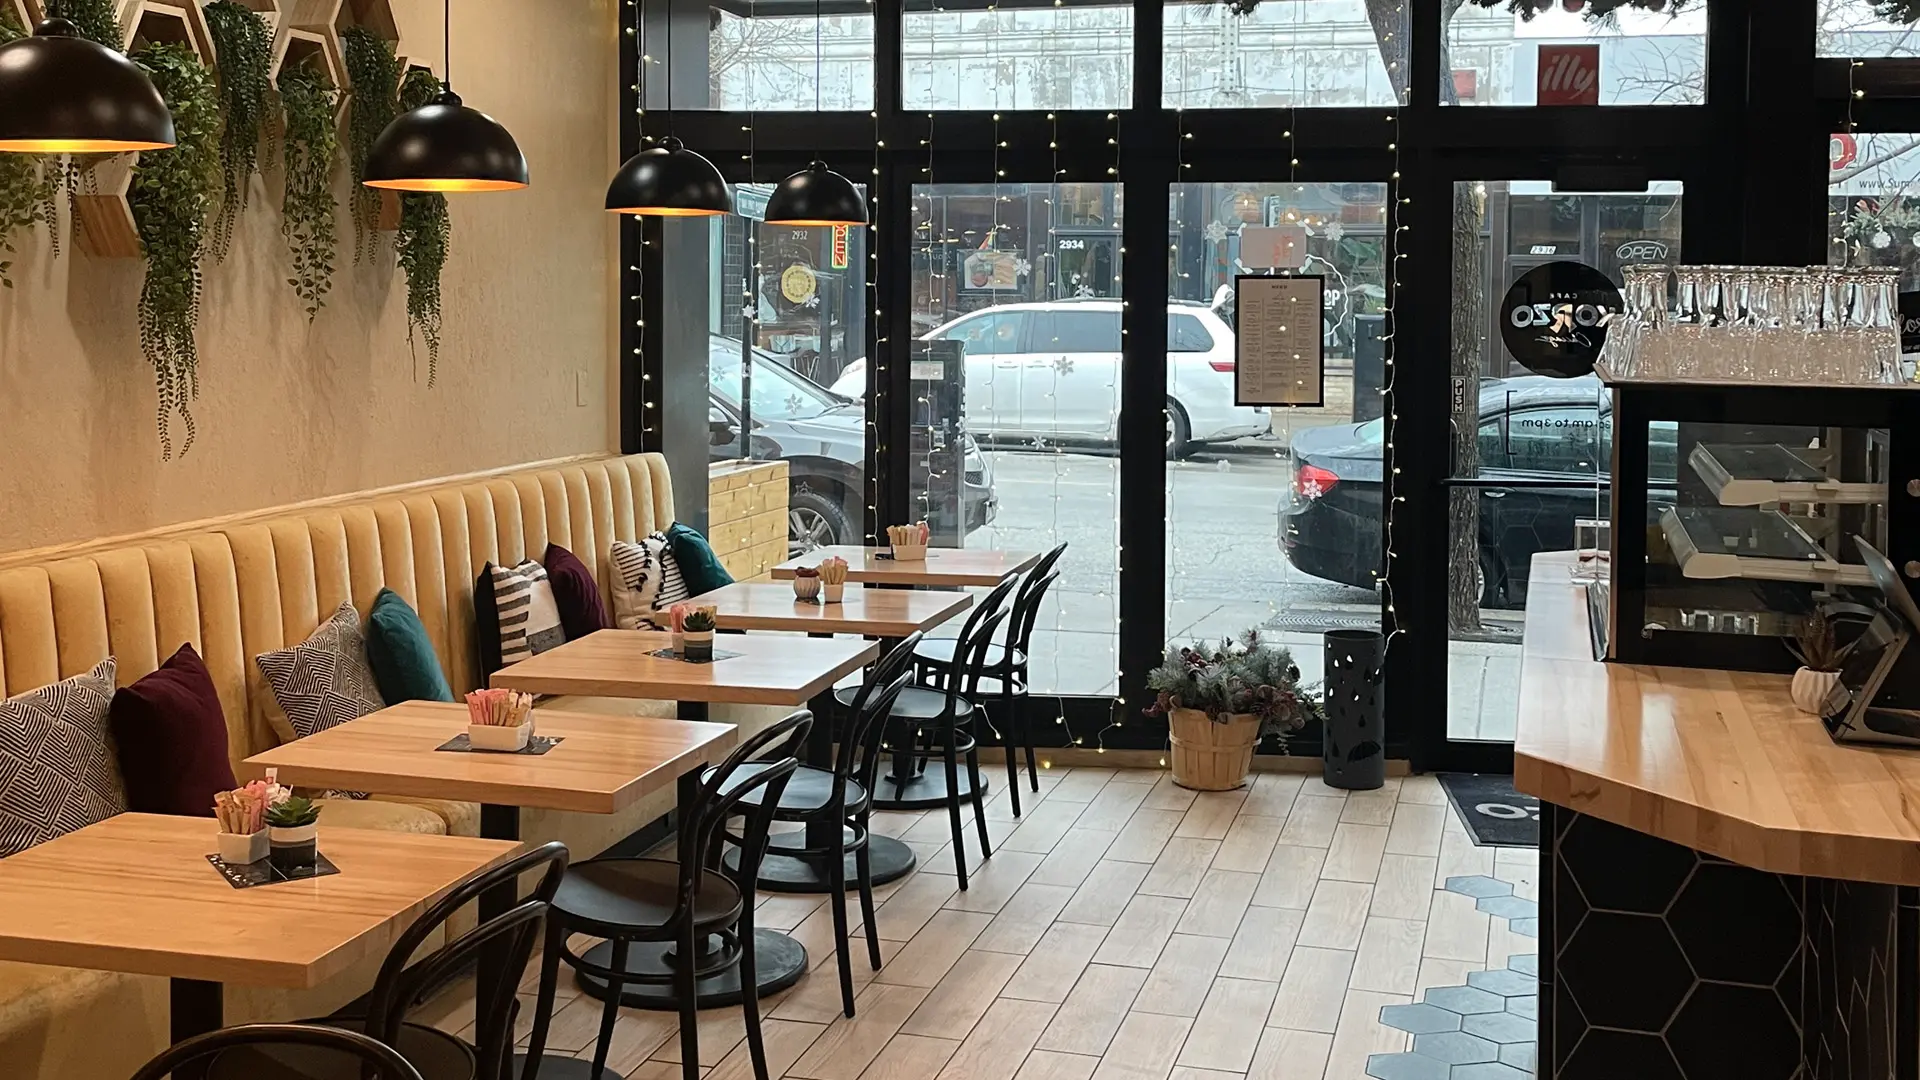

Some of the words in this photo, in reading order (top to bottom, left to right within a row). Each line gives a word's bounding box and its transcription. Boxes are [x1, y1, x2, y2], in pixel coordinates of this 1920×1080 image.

[1541, 53, 1596, 100] illy
[792, 230, 808, 241] 2932
[834, 225, 846, 266] PEN
[1059, 240, 1085, 249] 2934
[1617, 245, 1669, 260] OPEN
[1454, 379, 1464, 412] PUSH
